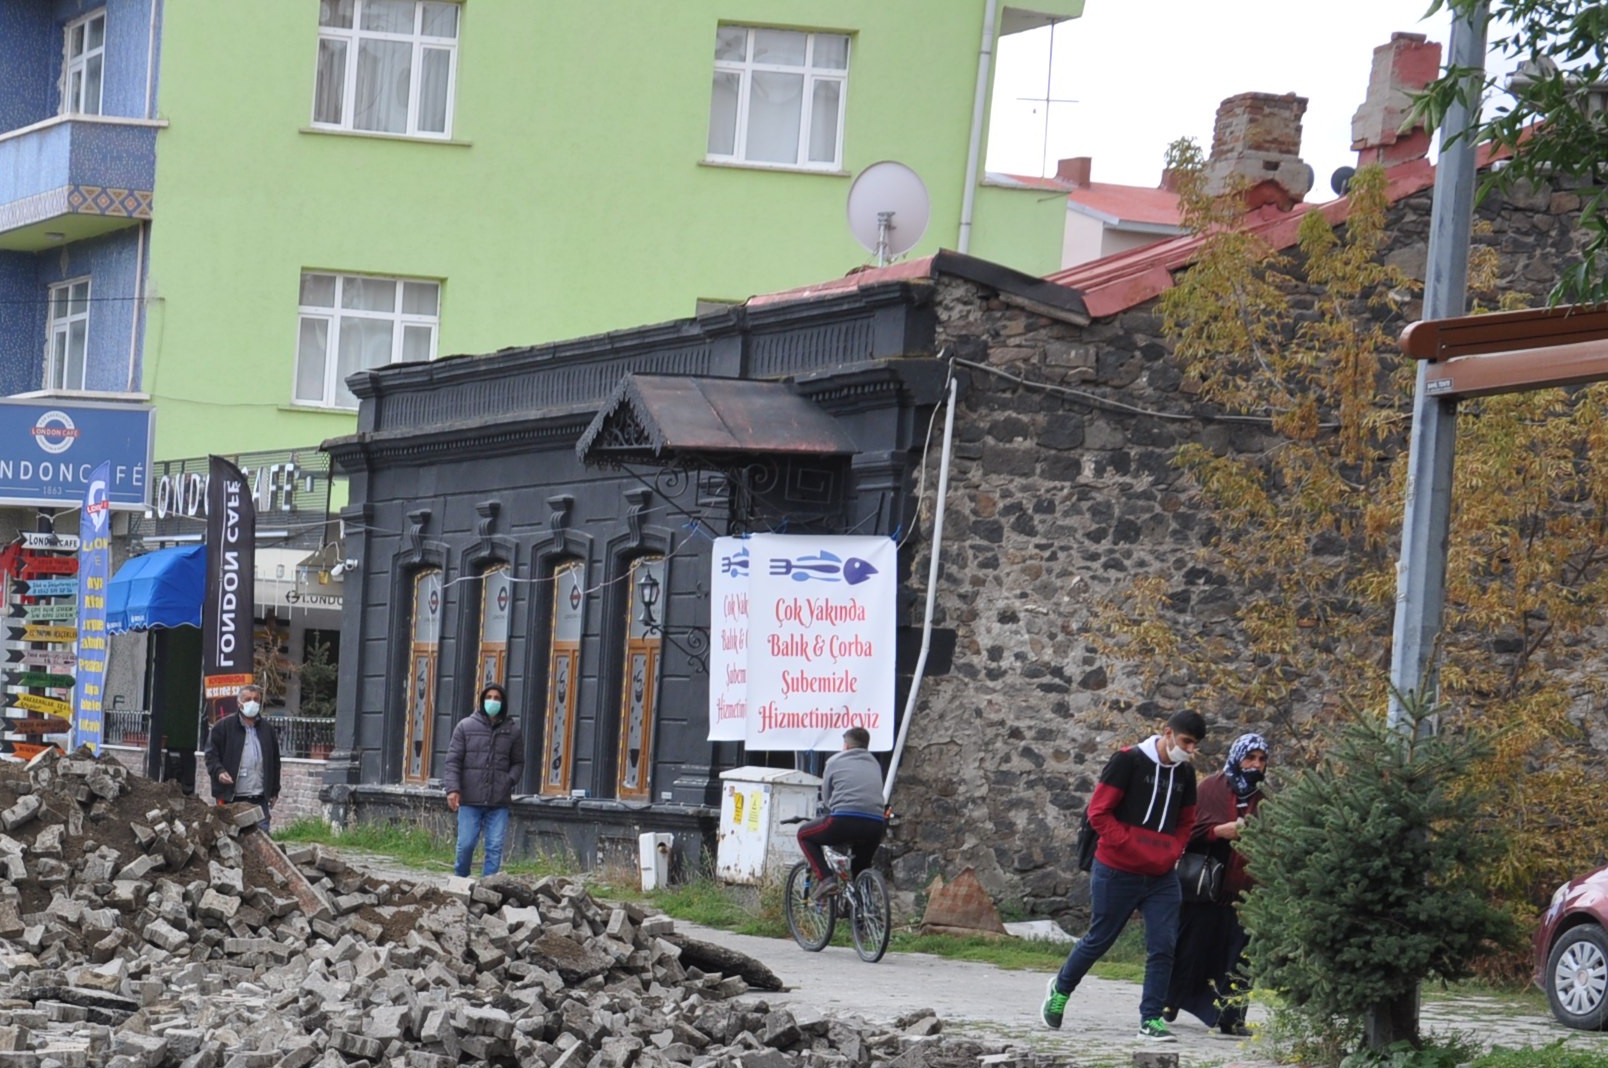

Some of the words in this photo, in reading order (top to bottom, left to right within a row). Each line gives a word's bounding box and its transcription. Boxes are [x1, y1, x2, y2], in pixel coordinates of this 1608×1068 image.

[775, 597, 804, 628] Çok
[803, 597, 866, 629] Yakında
[767, 633, 812, 662] Balık
[813, 634, 825, 657] &
[829, 633, 872, 665] Çorba
[781, 669, 858, 700] Şubemizle
[757, 700, 879, 733] Hizmetinizdeyiz
